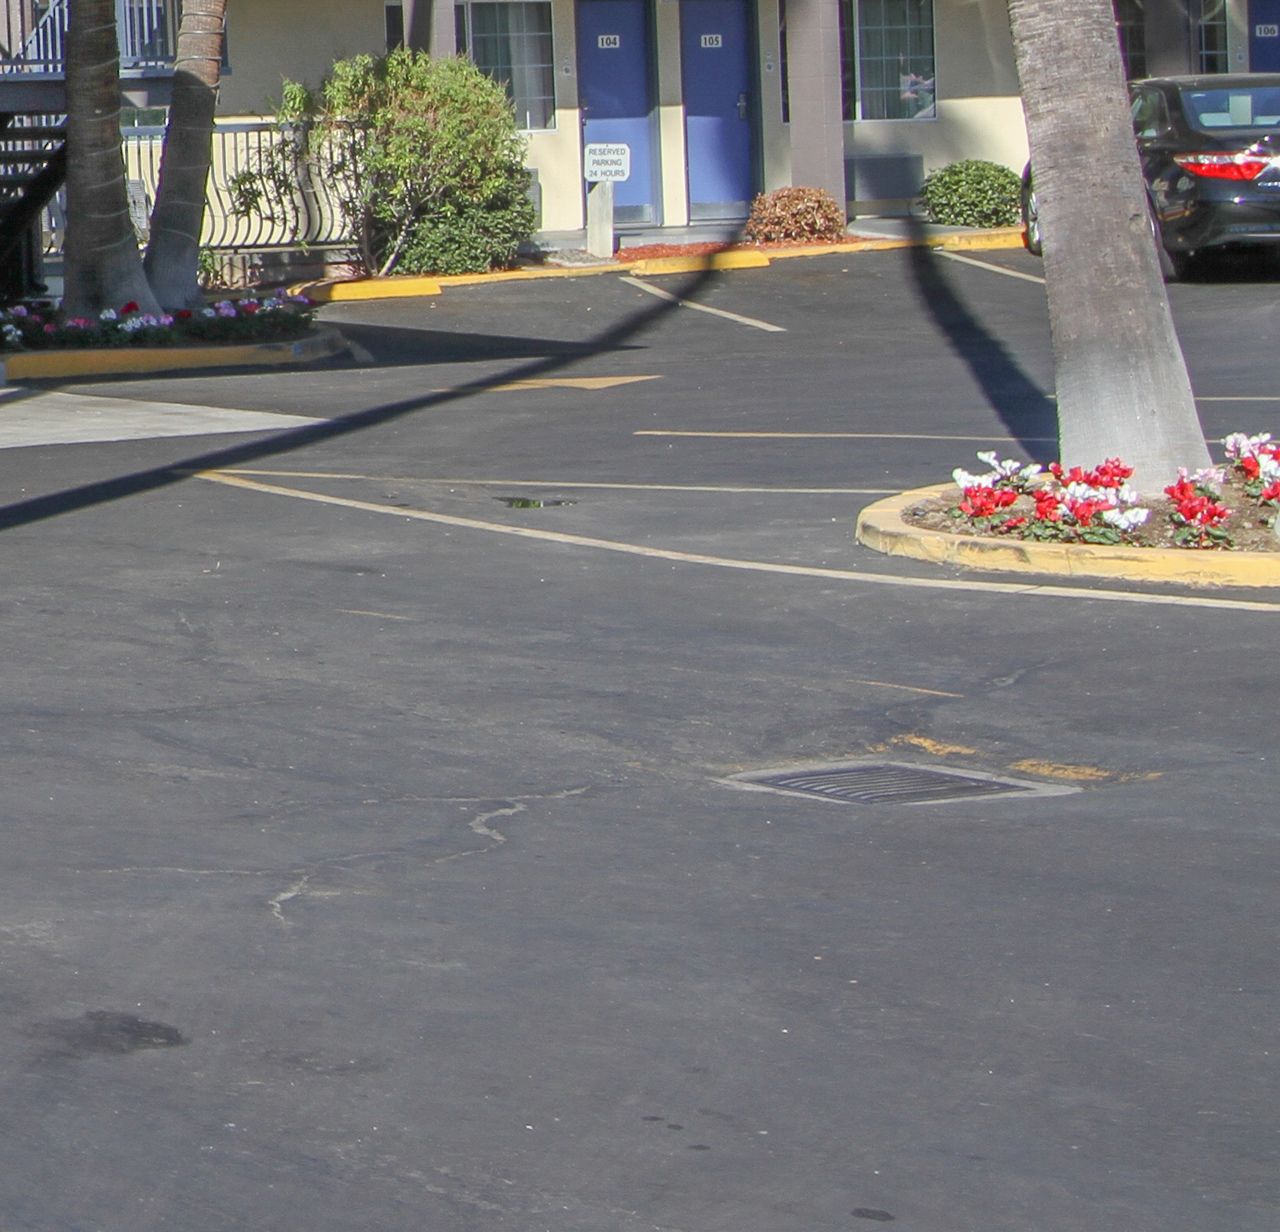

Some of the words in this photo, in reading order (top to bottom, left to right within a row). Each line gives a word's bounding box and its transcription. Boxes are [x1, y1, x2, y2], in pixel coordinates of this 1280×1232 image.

[600, 36, 617, 47] 104
[703, 36, 720, 46] 105
[589, 148, 626, 156] RESERVED
[592, 158, 622, 167] PARKING
[589, 169, 598, 177] 24
[600, 169, 626, 177] HOURS
